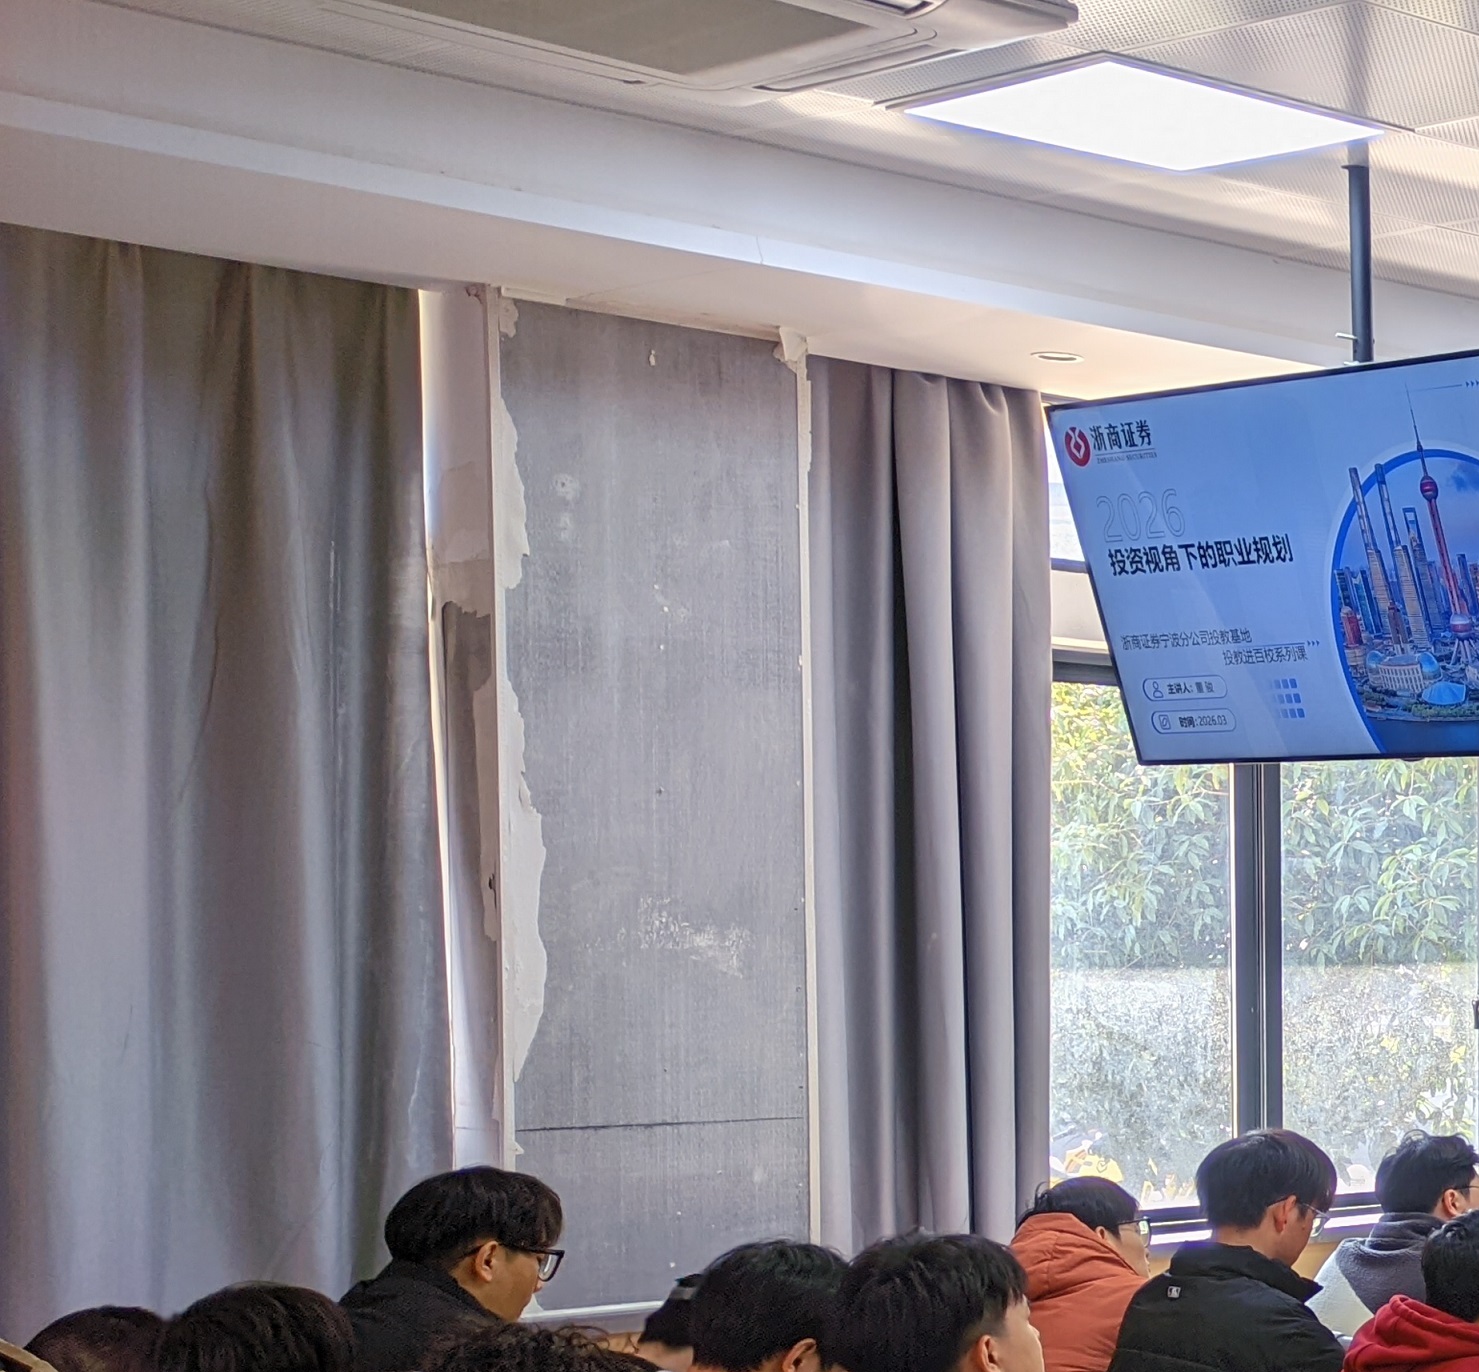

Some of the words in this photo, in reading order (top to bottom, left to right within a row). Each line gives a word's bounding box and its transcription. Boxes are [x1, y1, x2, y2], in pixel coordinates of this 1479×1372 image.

[1090, 420, 1152, 451] 浙商证券
[1096, 488, 1185, 544] 2026
[1108, 533, 1293, 577] 投资视角下的职业规划
[1121, 627, 1252, 650] 浙商证券宁波分公司投教基地
